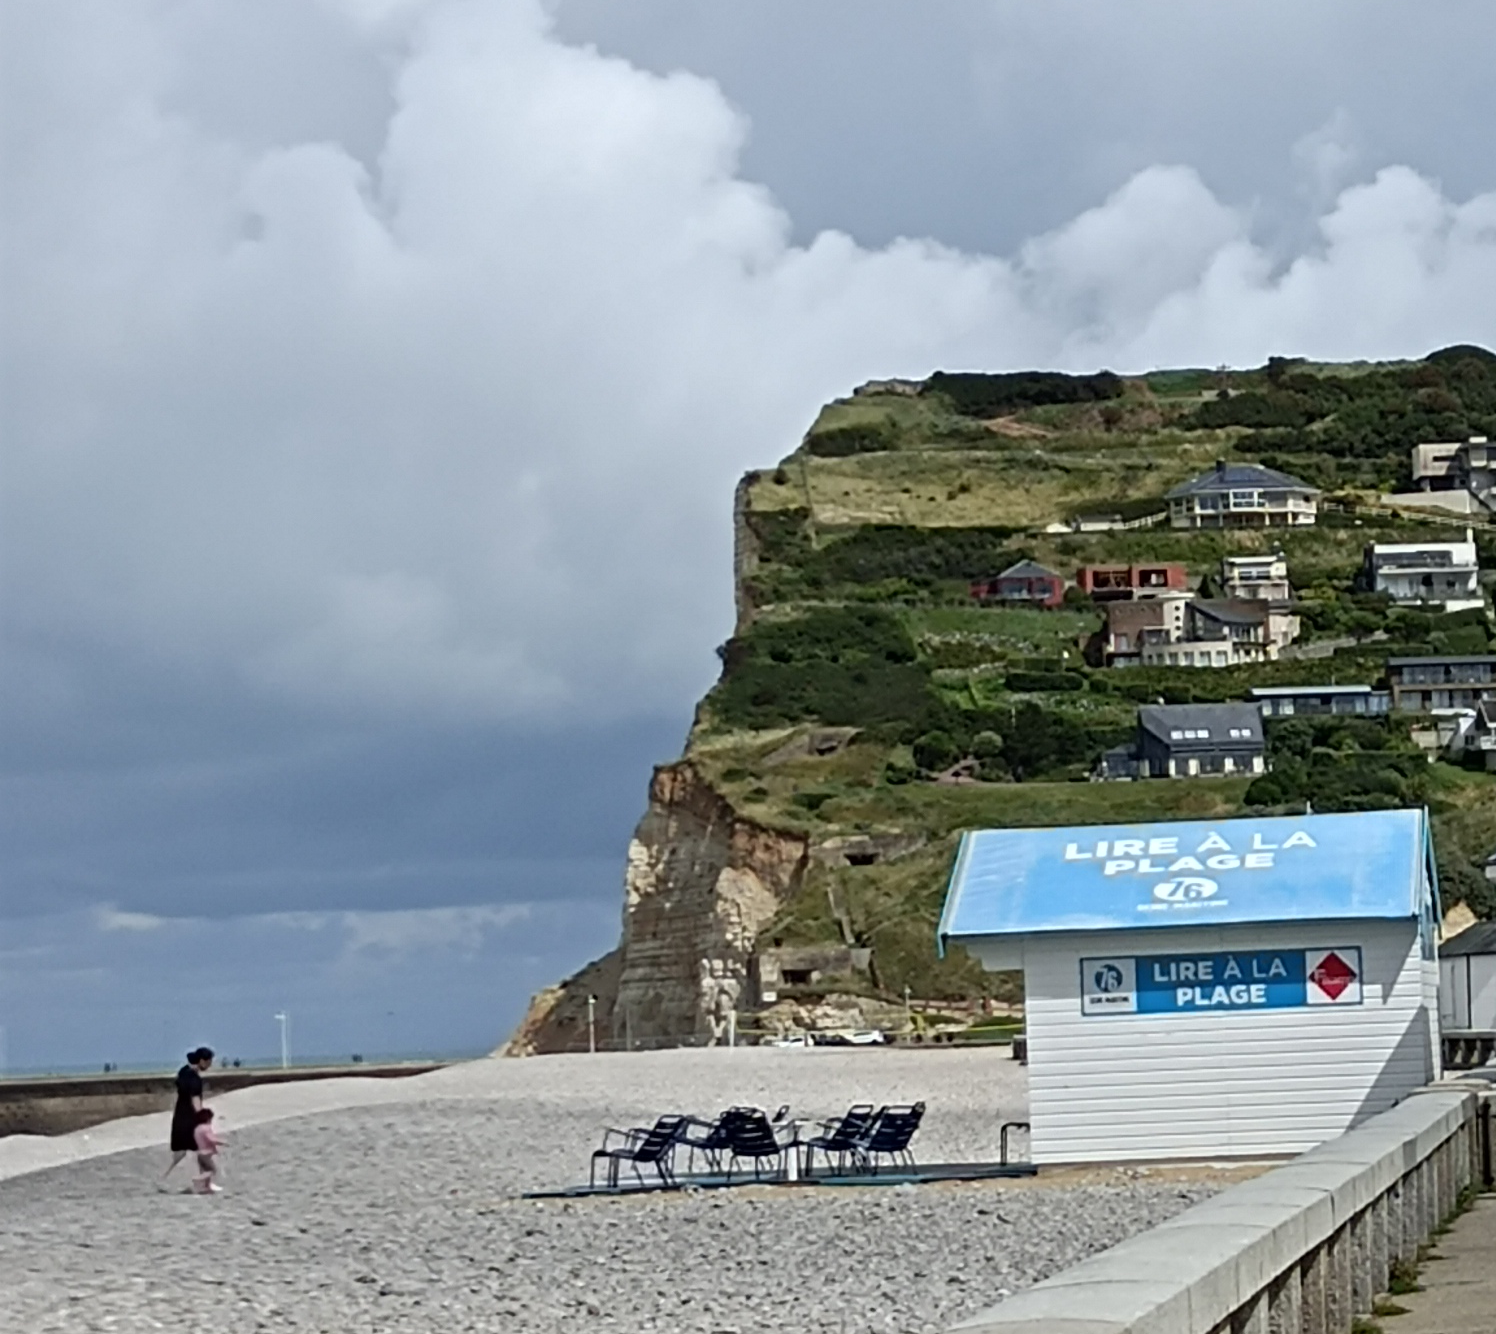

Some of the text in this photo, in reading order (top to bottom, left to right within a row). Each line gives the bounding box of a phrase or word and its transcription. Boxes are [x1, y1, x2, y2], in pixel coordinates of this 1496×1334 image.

[1065, 831, 1317, 860] LIRE À LA
[1104, 852, 1275, 875] PLAGE
[1097, 966, 1120, 992] 76
[1154, 955, 1287, 982] LIRE À LA
[1176, 984, 1267, 1006] PLAGE
